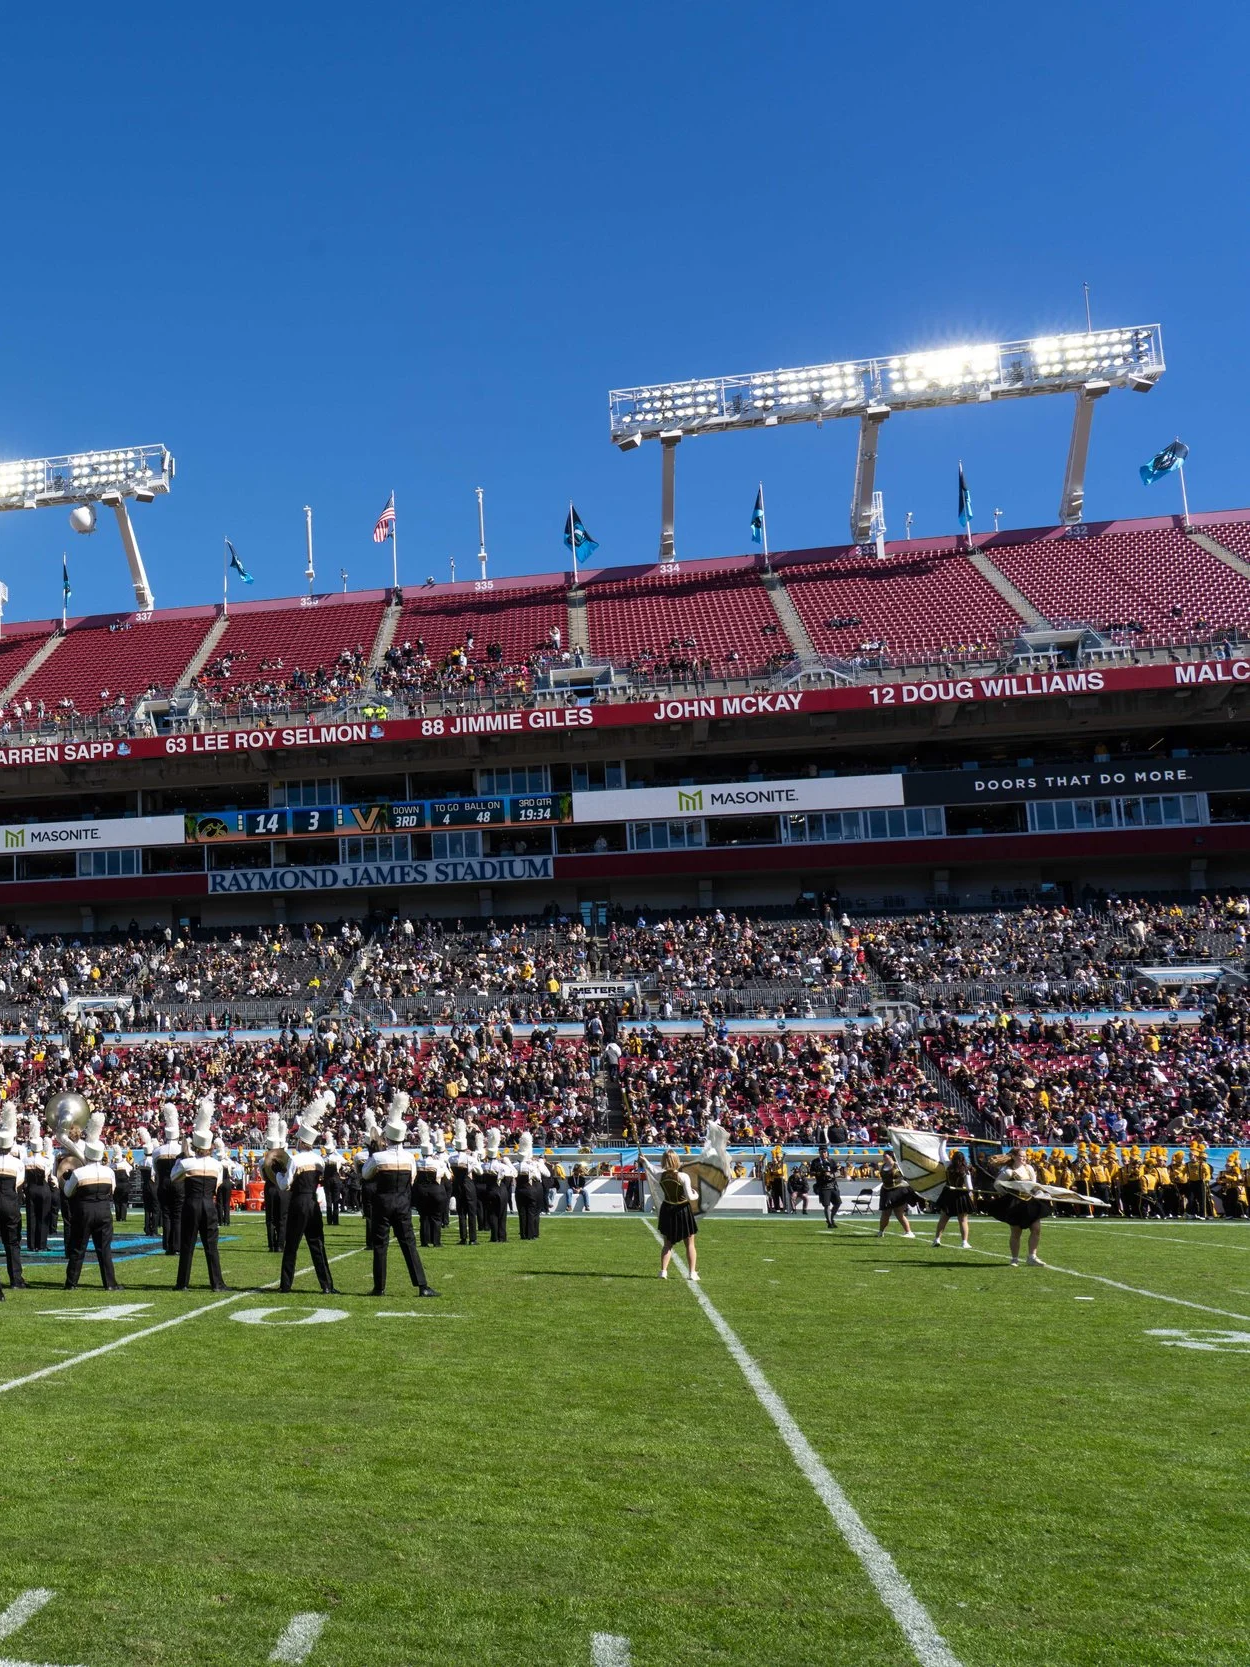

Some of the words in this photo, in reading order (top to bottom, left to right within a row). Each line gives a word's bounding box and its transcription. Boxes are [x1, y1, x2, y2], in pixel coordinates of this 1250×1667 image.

[1066, 526, 1088, 536] 332
[856, 545, 876, 556] 333
[660, 564, 680, 573] 334
[474, 581, 494, 590] 335
[300, 596, 318, 606] 336
[136, 612, 152, 621] 337
[869, 688, 894, 704] 12
[902, 682, 974, 702] DOUG
[980, 672, 1104, 697] WILLIAMS
[654, 700, 715, 720] JOHN
[722, 693, 802, 715] MCKAY
[421, 720, 444, 735] 88
[450, 714, 523, 734] JIMMIE
[528, 709, 593, 728] GILES
[165, 737, 186, 753] 63
[192, 733, 229, 751] LEE
[235, 729, 277, 748] ROY
[282, 725, 366, 746] SELMON
[64, 742, 114, 760] SAPP
[975, 778, 1037, 791] DOORS
[1045, 774, 1091, 787] THAT
[1101, 773, 1125, 784] DO
[435, 804, 445, 812] TO
[465, 802, 485, 810] BALL
[488, 801, 500, 809] ON
[519, 799, 535, 807] 3RD
[536, 798, 552, 806] QTR
[393, 806, 419, 816] DOWN
[442, 814, 450, 824] 4
[477, 811, 490, 822] 48
[519, 808, 551, 820] 19:34
[255, 814, 278, 832] 14
[308, 812, 319, 830] 3
[351, 807, 380, 831] V
[395, 815, 417, 828] 3RD
[209, 868, 338, 893] RAYMOND
[343, 863, 427, 887] JAMES
[435, 858, 553, 883] STADIUM
